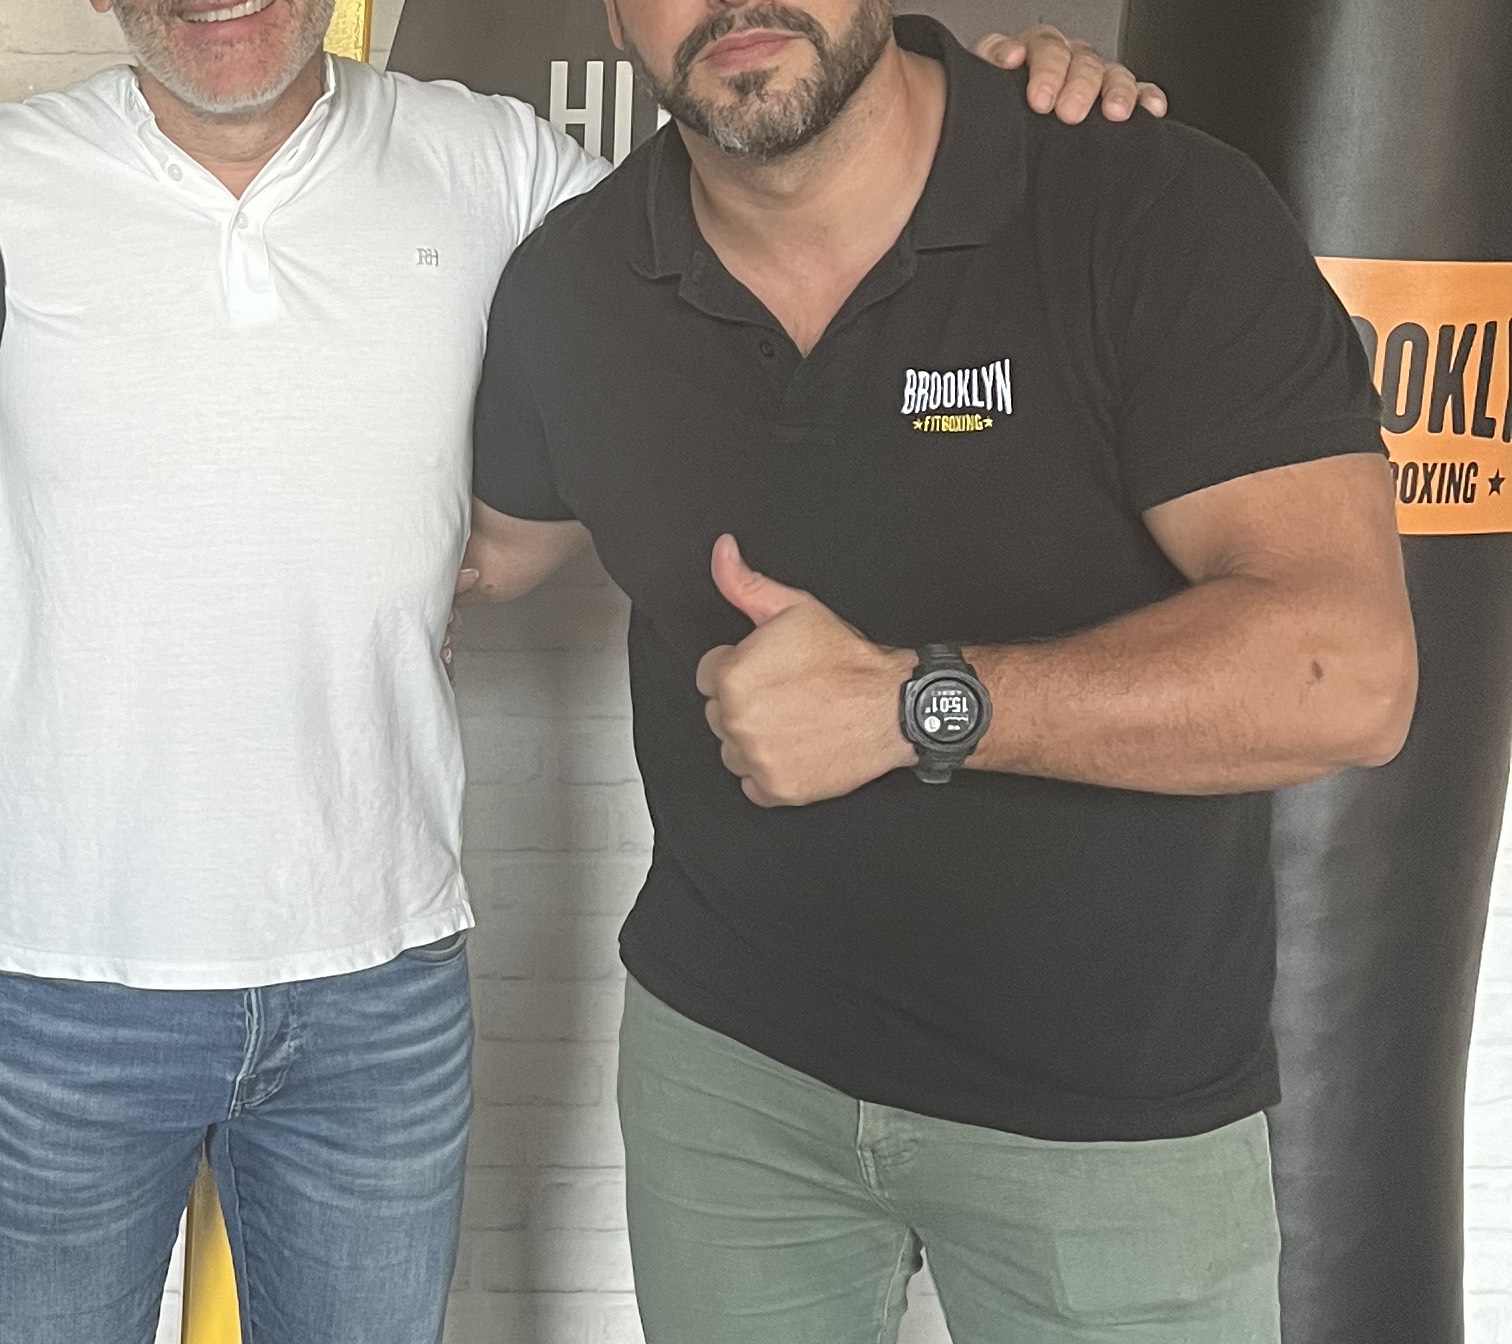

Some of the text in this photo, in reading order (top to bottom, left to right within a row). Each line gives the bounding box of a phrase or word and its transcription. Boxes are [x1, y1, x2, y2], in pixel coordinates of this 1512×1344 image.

[549, 60, 671, 167] HI
[900, 358, 1013, 415] BROOKLYN
[1351, 315, 1512, 444] OKL
[923, 414, 984, 433] FITBOXING
